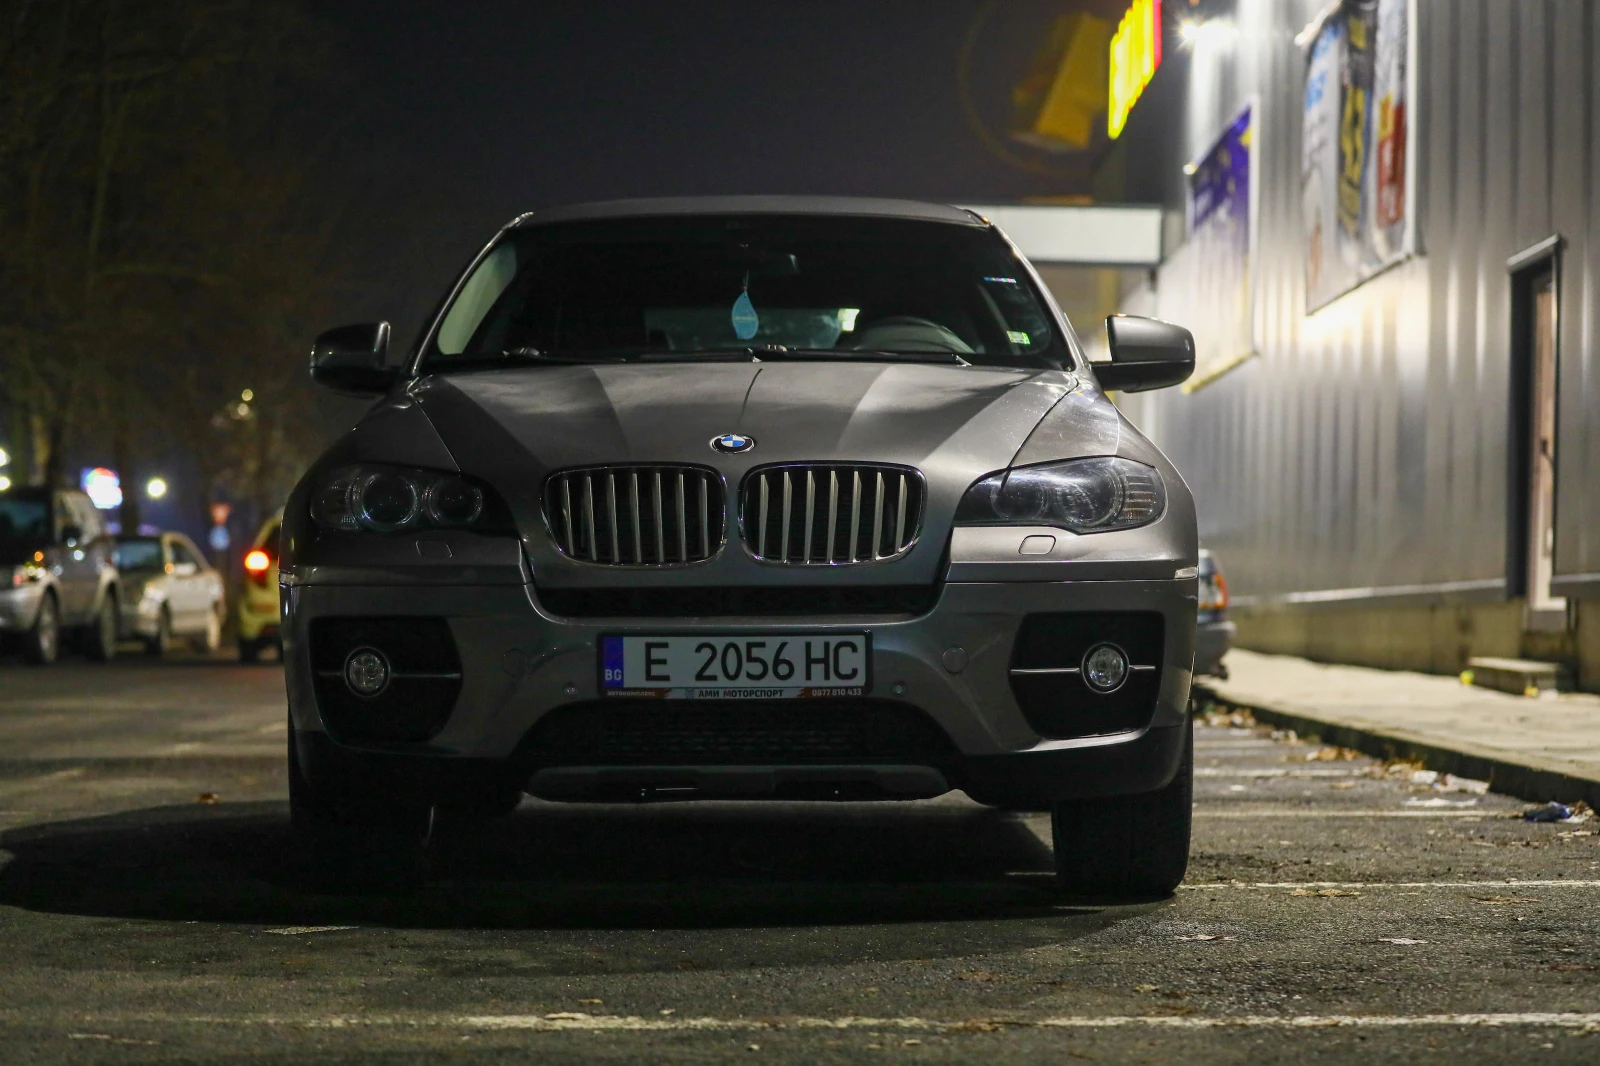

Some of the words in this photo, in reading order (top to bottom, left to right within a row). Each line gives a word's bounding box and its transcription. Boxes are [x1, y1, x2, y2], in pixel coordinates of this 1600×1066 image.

[694, 641, 795, 682] 2056
[604, 668, 622, 681] BG
[723, 688, 785, 698] МОТОРСПОРТ
